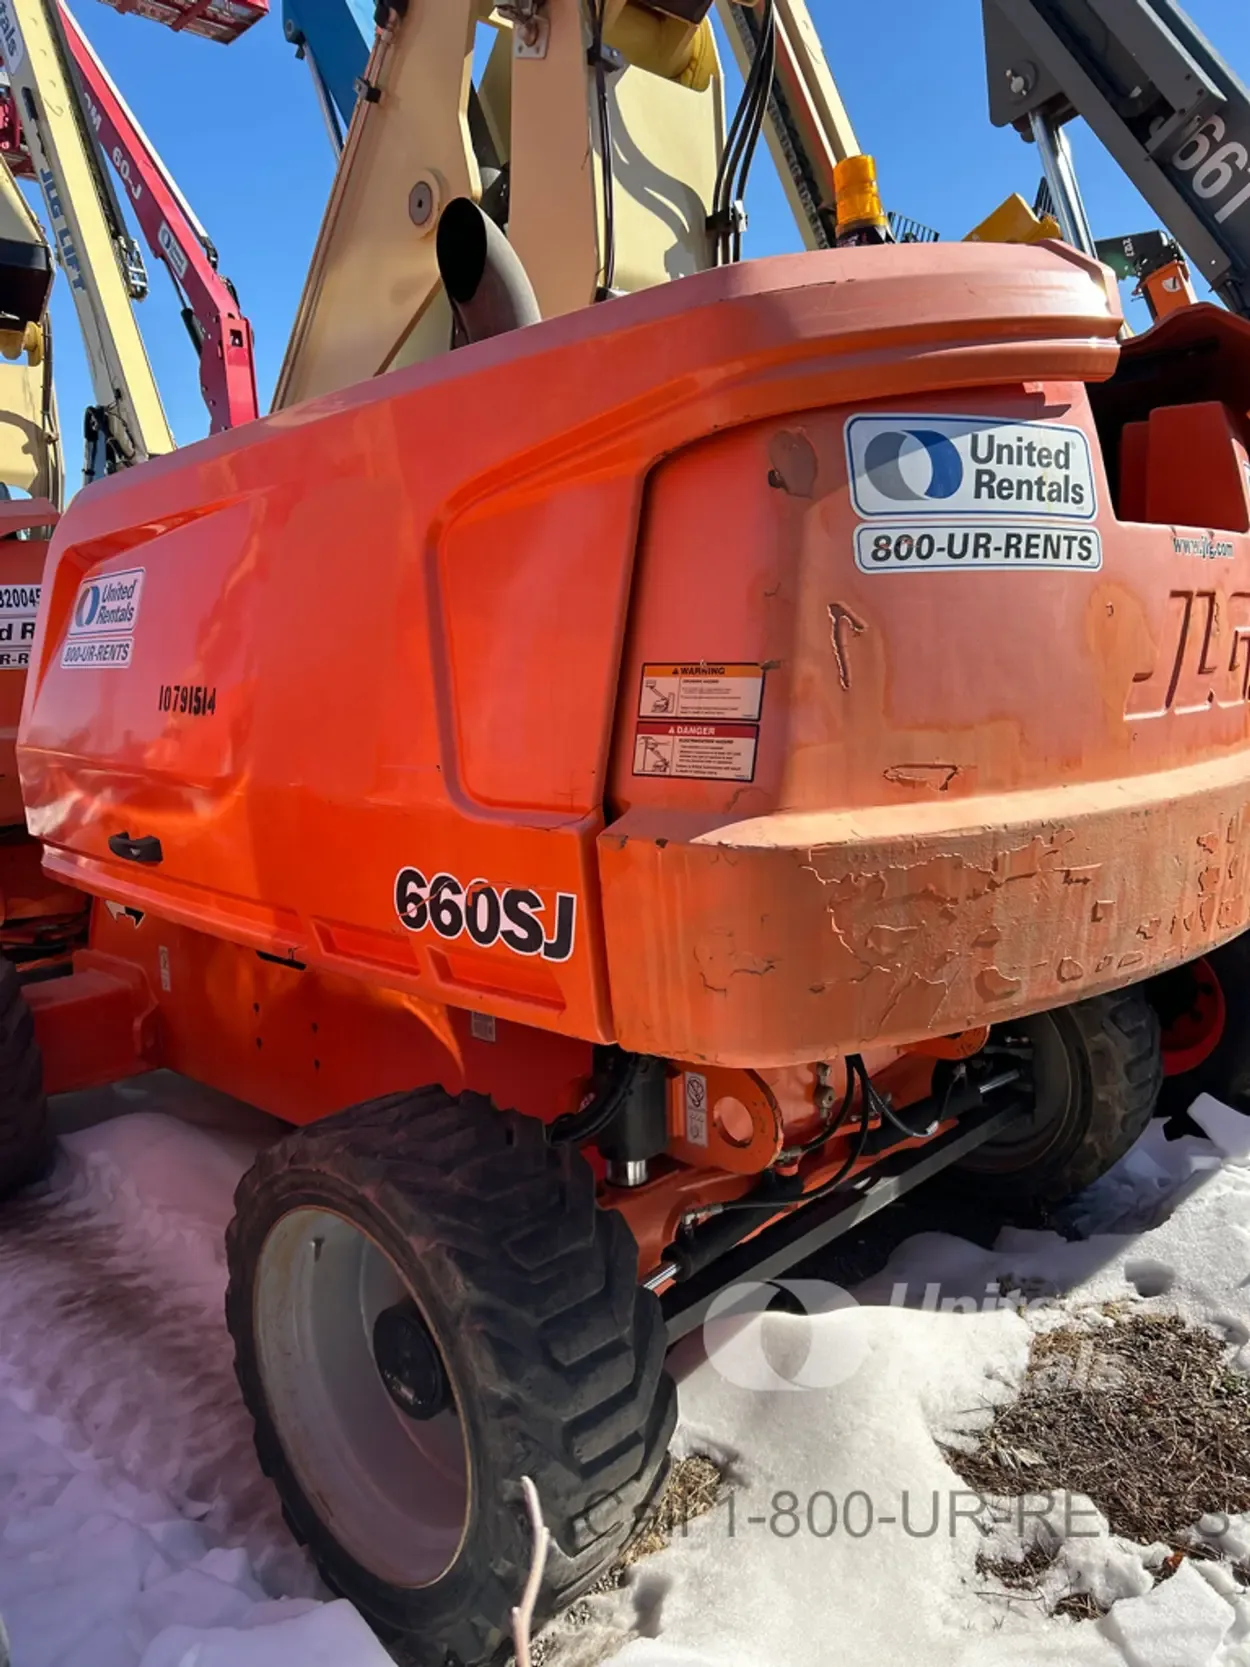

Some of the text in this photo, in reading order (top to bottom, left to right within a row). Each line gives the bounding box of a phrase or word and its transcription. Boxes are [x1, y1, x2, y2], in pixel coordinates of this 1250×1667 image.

[112, 147, 143, 200] 60-J
[40, 168, 86, 290] JLG LIFT
[970, 432, 1072, 470] United
[973, 468, 1085, 505] Rentals
[870, 531, 1093, 562] 800-UR-RENTS
[101, 579, 138, 603] United
[96, 601, 135, 625] Rentals
[680, 666, 725, 676] WARNING
[158, 685, 216, 716] 10791514
[677, 726, 715, 736] DANGER
[394, 866, 577, 962] 660SJ
